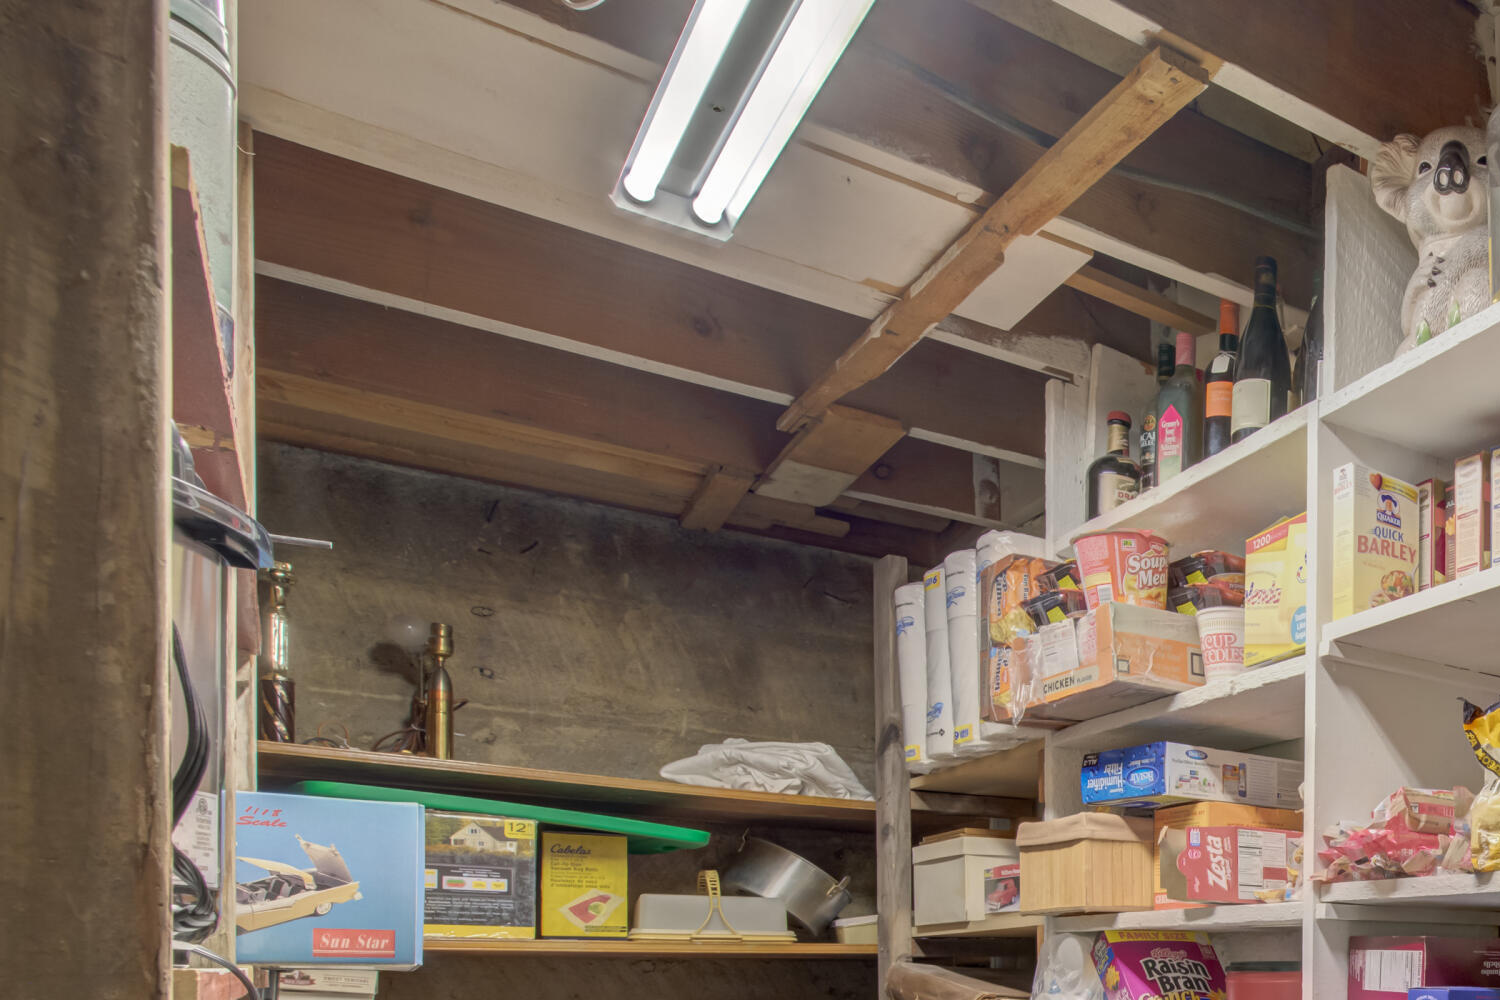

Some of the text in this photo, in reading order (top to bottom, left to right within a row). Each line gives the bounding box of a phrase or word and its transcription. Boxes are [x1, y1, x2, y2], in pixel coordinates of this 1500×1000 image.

[1377, 512, 1401, 527] QUAKER
[1252, 534, 1271, 550] 1200
[1374, 526, 1404, 542] QUICK
[1357, 535, 1417, 564] BARLEY
[1204, 634, 1236, 649] CUP
[1042, 676, 1075, 694] CHICKEN
[236, 815, 287, 828] Scale
[1206, 835, 1229, 891] Zesta
[319, 933, 390, 949] Sun Star
[1118, 932, 1189, 940] FAMILY SIZE
[1142, 959, 1209, 979] Raisin
[1160, 977, 1209, 993] Bran
